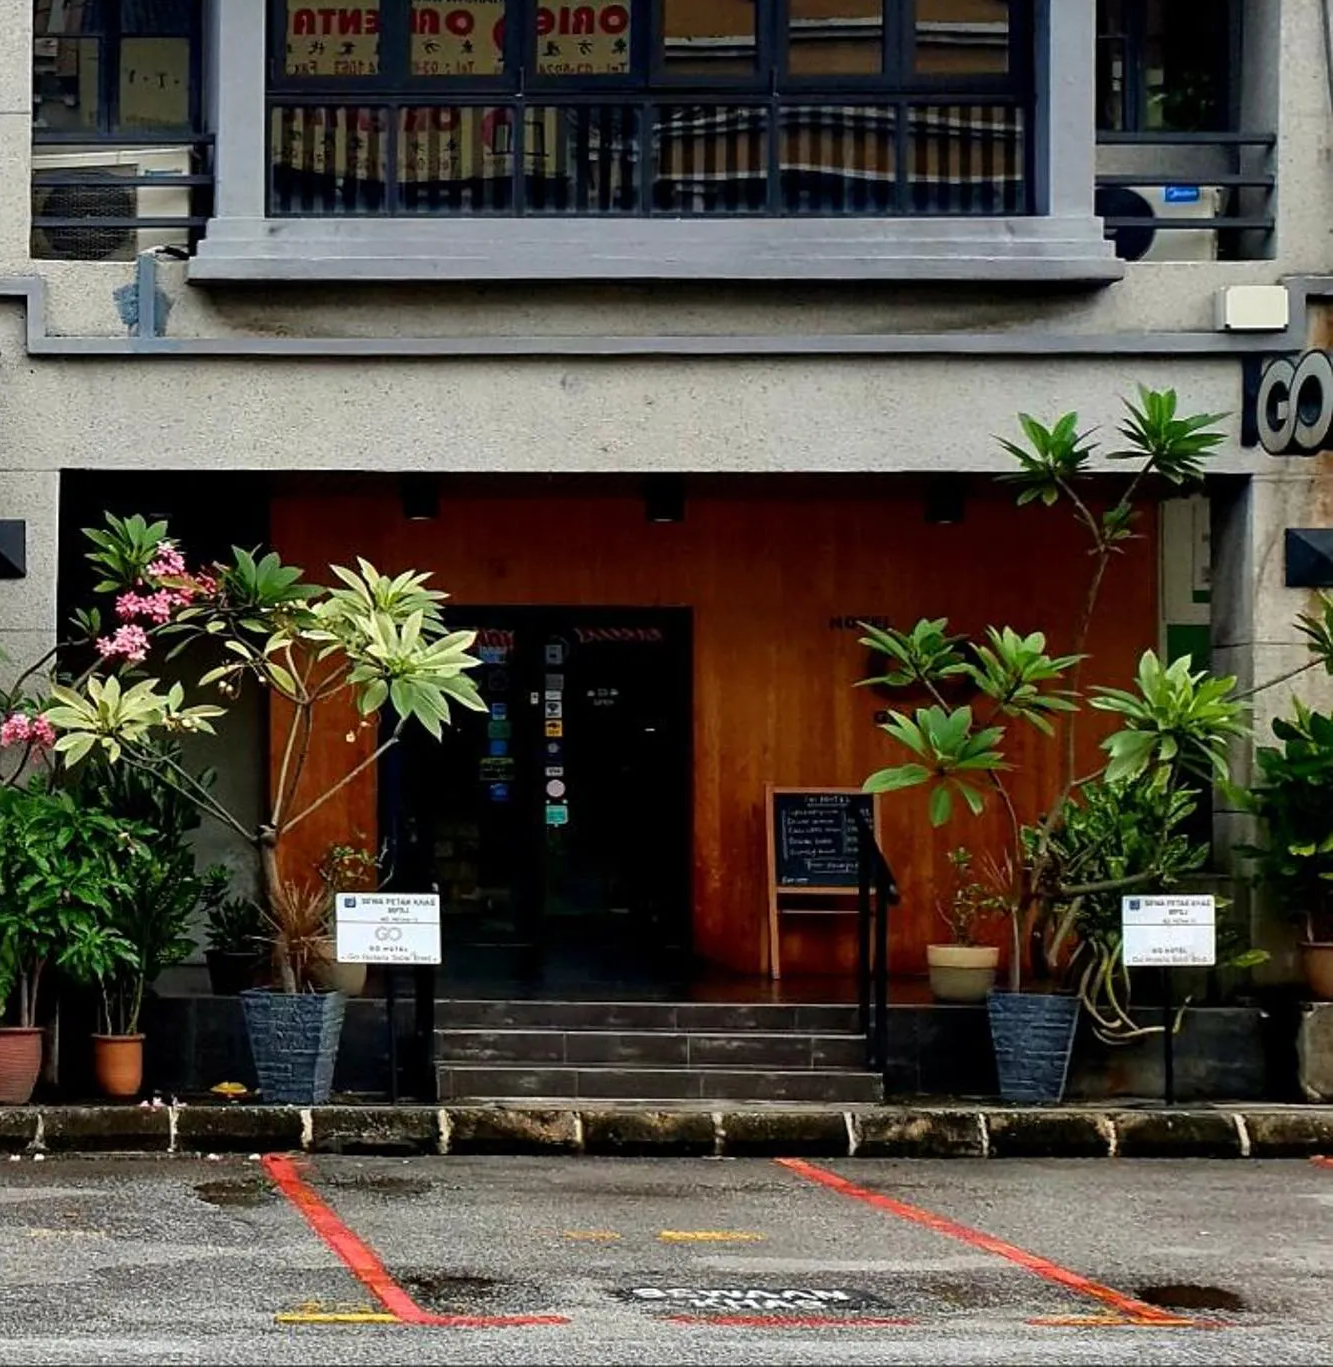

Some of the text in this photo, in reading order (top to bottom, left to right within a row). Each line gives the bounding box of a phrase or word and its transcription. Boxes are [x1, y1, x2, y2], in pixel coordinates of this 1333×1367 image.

[1256, 349, 1333, 456] GO
[632, 1287, 850, 1300] SEWAAN
[689, 1298, 827, 1310] KHAS
